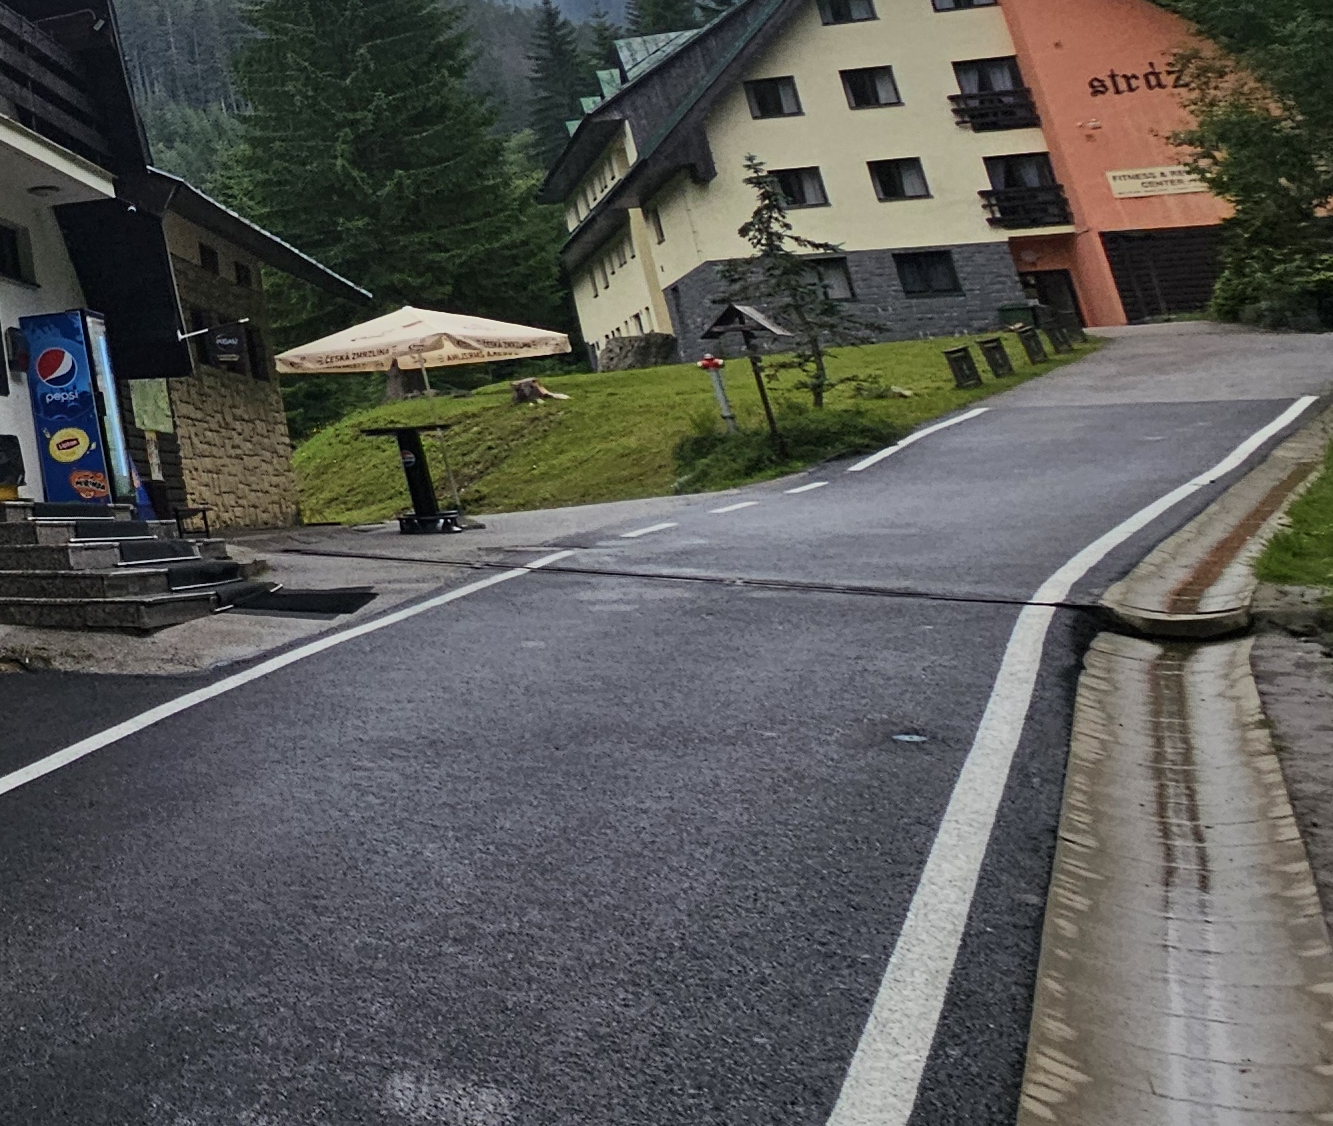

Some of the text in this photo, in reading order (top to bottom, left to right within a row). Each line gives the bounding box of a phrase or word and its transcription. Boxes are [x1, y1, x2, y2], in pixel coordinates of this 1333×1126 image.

[1112, 171, 1157, 182] FITNESS
[1140, 178, 1185, 189] CENTER
[45, 391, 79, 404] pepsi
